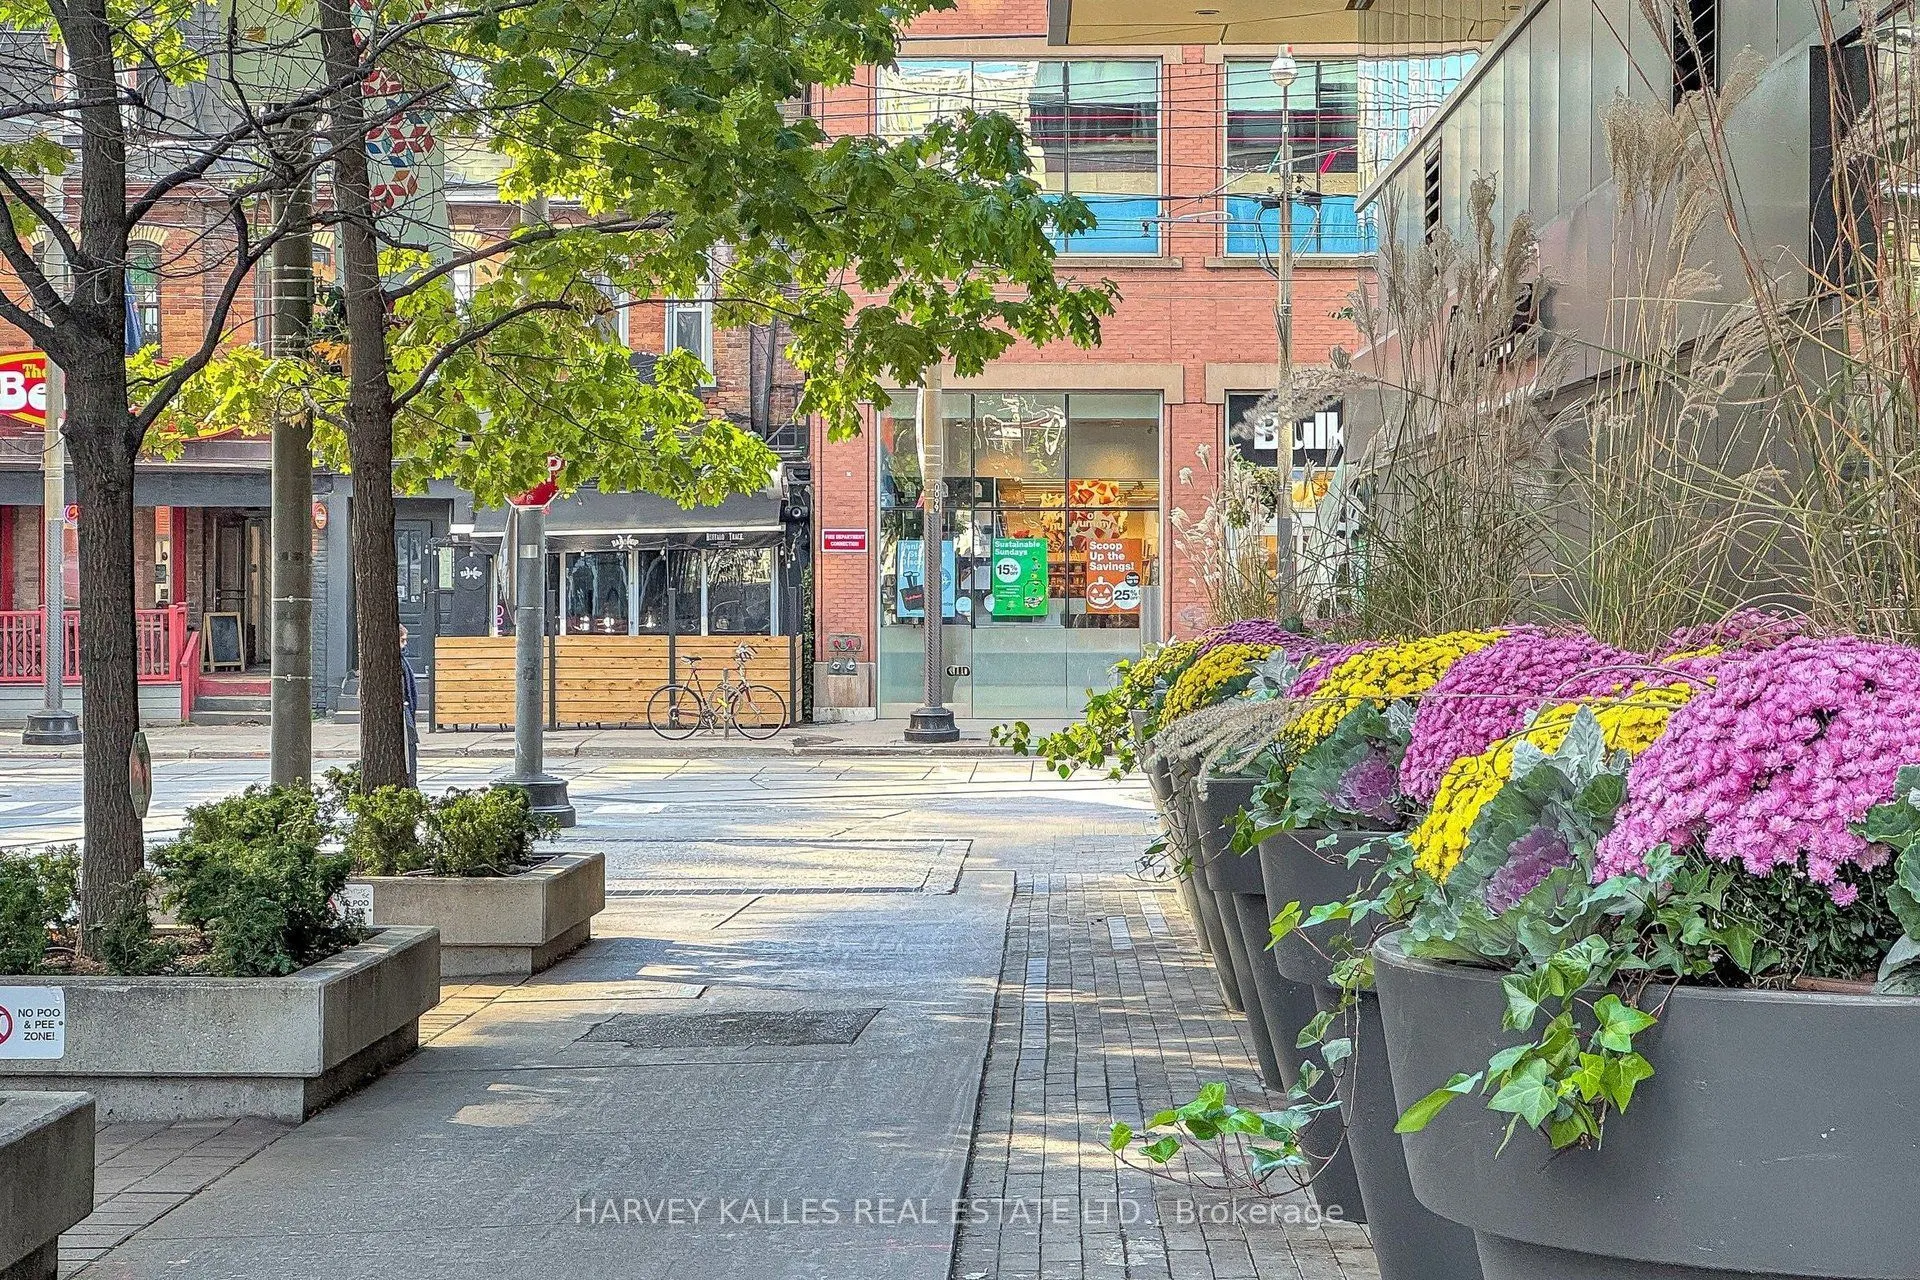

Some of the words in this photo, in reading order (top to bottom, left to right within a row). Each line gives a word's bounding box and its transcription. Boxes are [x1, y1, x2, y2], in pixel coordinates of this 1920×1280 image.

[1253, 411, 1344, 450] Bulk
[994, 540, 1041, 548] Sustainable
[1089, 541, 1123, 551] Scoop
[994, 548, 1028, 556] Sundays
[1089, 551, 1105, 561] Up
[1107, 551, 1125, 560] the
[1089, 562, 1135, 573] Savings!
[352, 899, 370, 907] POO
[17, 1008, 34, 1018] NO
[36, 1008, 61, 1018] POO
[23, 1020, 32, 1029] &
[34, 1020, 55, 1029] PEE
[23, 1031, 55, 1041] ZONE!
